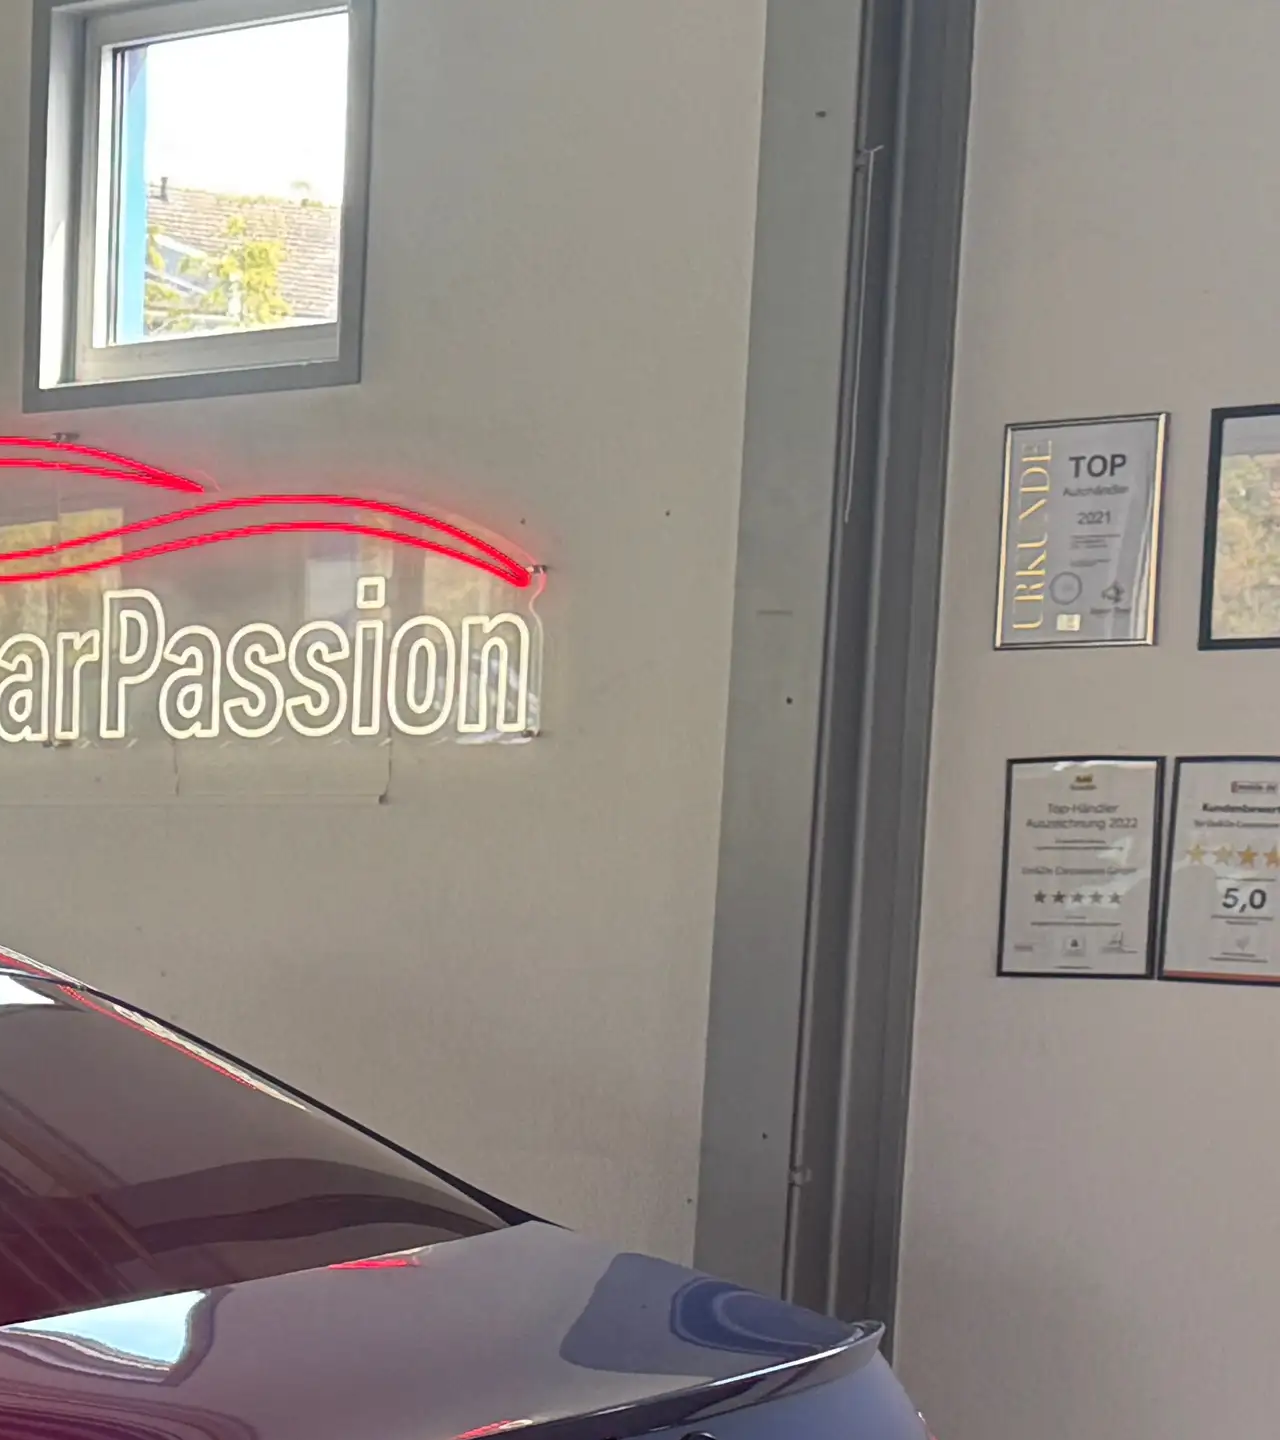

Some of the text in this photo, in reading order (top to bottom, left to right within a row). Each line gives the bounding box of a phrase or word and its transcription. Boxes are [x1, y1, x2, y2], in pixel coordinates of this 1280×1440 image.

[1068, 453, 1127, 479] TOP
[1076, 510, 1112, 526] 2021
[1012, 440, 1053, 630] URKUNDE
[1221, 887, 1268, 914] 5,0
